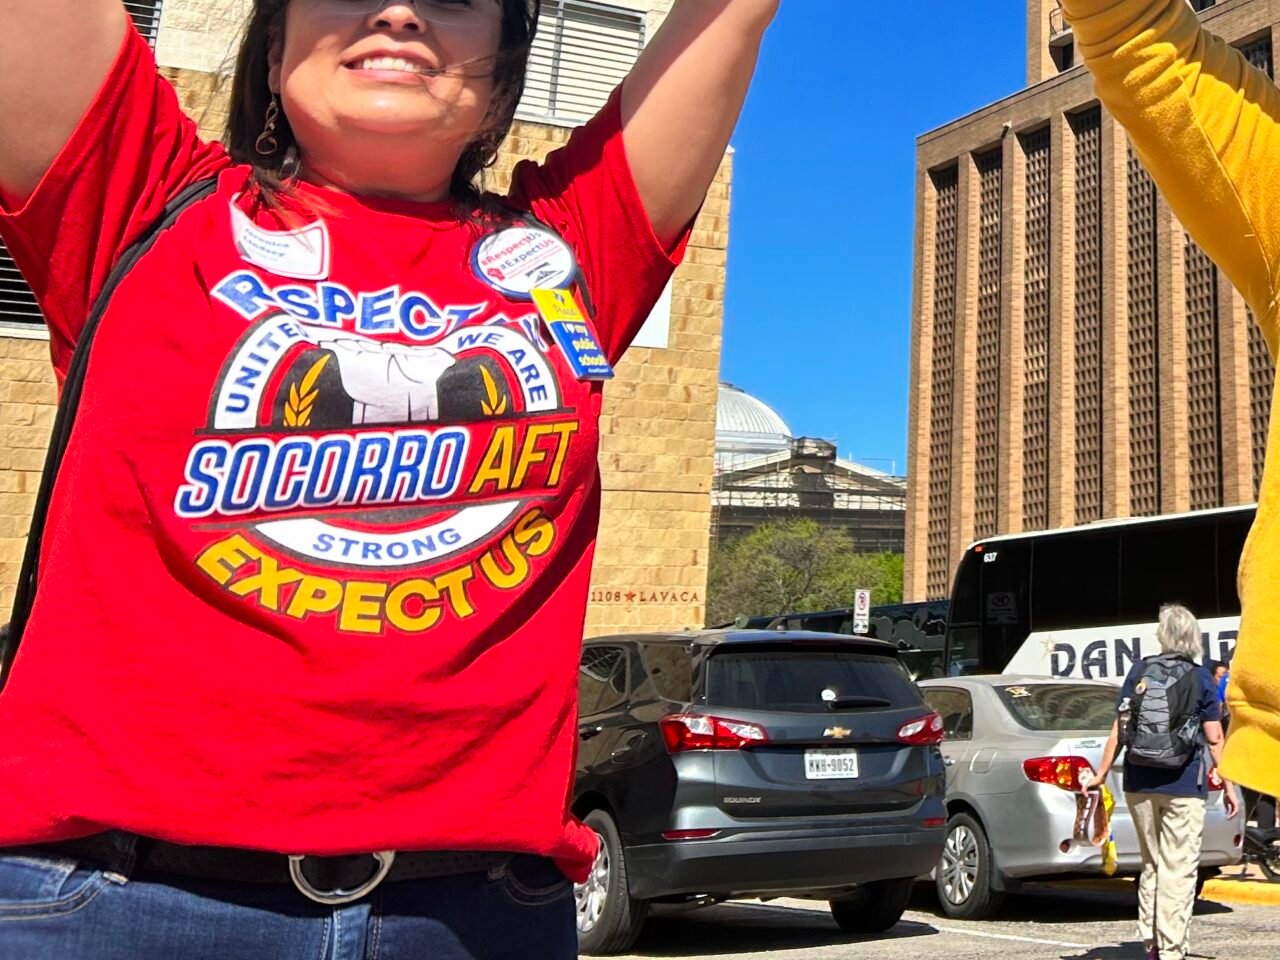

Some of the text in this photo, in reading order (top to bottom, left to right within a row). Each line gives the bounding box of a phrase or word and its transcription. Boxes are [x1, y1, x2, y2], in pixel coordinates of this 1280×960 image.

[480, 230, 543, 267] #RespectUs
[499, 238, 555, 271] #ExpectUs
[456, 330, 505, 351] WE
[507, 347, 549, 404] ARE
[176, 421, 579, 517] SOCORRO AFT
[311, 527, 463, 561] STRONG
[983, 552, 998, 563] 637
[196, 506, 559, 634] EXPECT US
[591, 591, 700, 602] 1108 LAVACA
[1050, 637, 1142, 680] DAN
